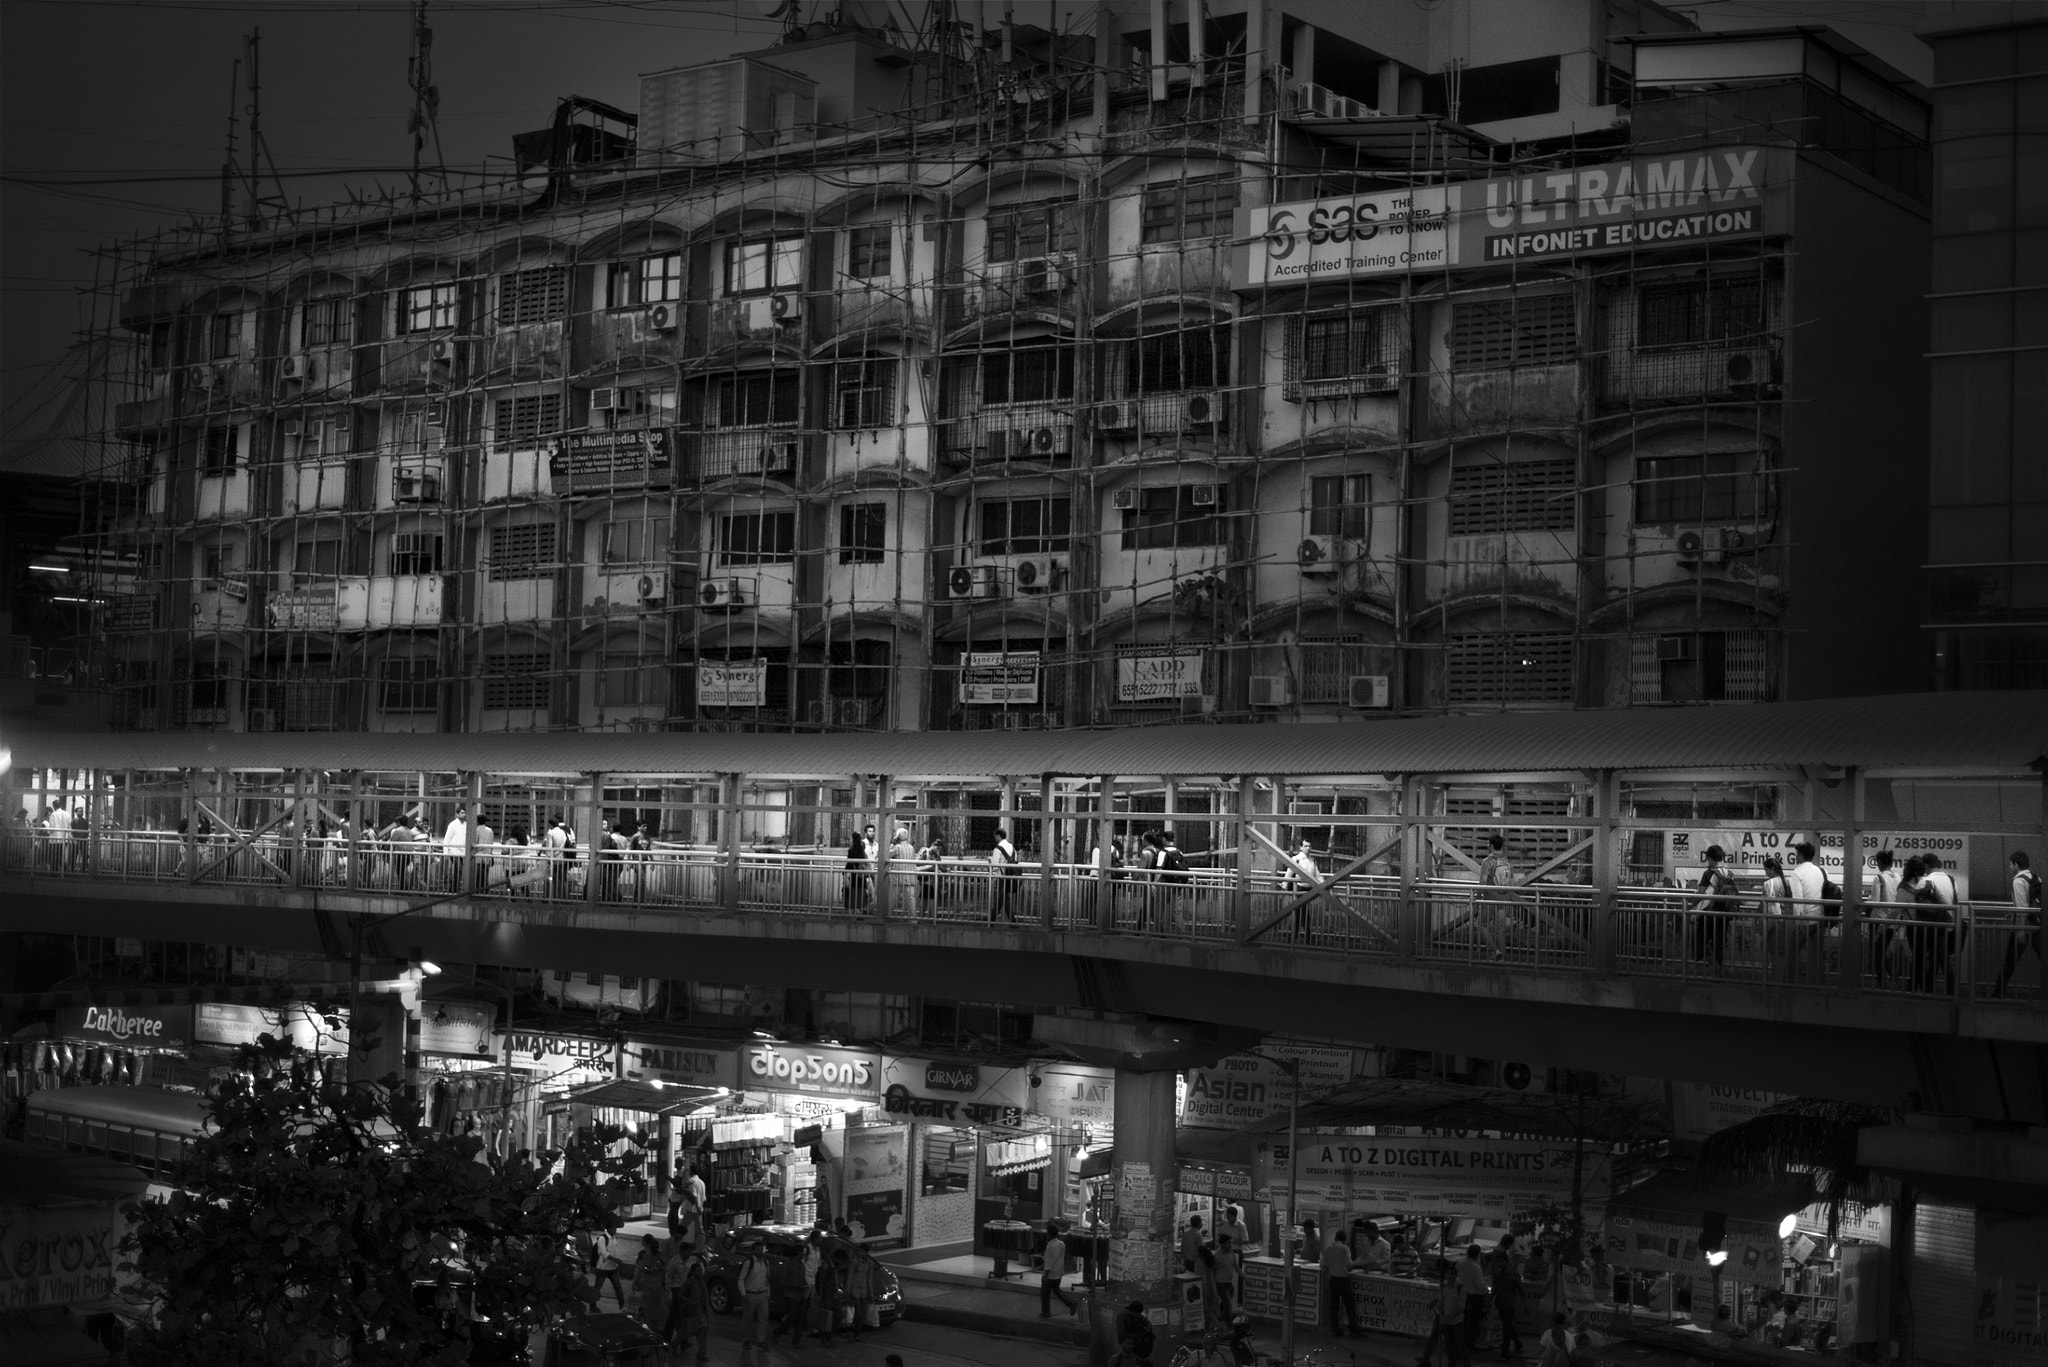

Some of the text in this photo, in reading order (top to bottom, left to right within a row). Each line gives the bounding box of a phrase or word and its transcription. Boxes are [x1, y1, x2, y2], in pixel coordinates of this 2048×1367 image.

[1486, 150, 1759, 229] ULTRAMAX
[1392, 198, 1413, 210] THE
[1389, 225, 1404, 236] TO
[1408, 221, 1444, 234] KNOW
[1605, 210, 1752, 245] EDUCATION
[1492, 228, 1599, 258] INFONET
[1274, 248, 1444, 277] Accredited Training Center
[582, 433, 636, 448] Multimedia
[1135, 660, 1185, 674] CADD
[1741, 832, 1755, 848] A
[1760, 832, 1779, 848] to
[1894, 837, 1963, 850] 26830099
[502, 1035, 601, 1058] AMARDEEP
[1278, 1046, 1350, 1058] Colour Printout
[641, 1047, 717, 1075] PARISUN
[1224, 1058, 1258, 1072] PHOTO
[1300, 1059, 1340, 1069] Printout
[927, 1069, 973, 1089] GIRNAR
[1190, 1072, 1266, 1103] Asian
[1187, 1100, 1264, 1118] Digital Centre
[1709, 1101, 1759, 1116] STATIONERY
[1321, 1146, 1334, 1163] A
[1337, 1147, 1363, 1165] TO
[1367, 1147, 1379, 1165] Z
[1384, 1148, 1464, 1169] DIGITAL
[1470, 1151, 1545, 1171] PRINTS
[1181, 1170, 1213, 1183] PHOTO
[1220, 1175, 1248, 1187] COLOUR
[1358, 1169, 1374, 1177] SCAN
[1380, 1170, 1395, 1178] PLOT
[1181, 1181, 1213, 1194] FRAME
[1217, 1186, 1250, 1198] PRINTOUTS
[1655, 1257, 1677, 1271] 2015
[1679, 1260, 1705, 1277] Diary
